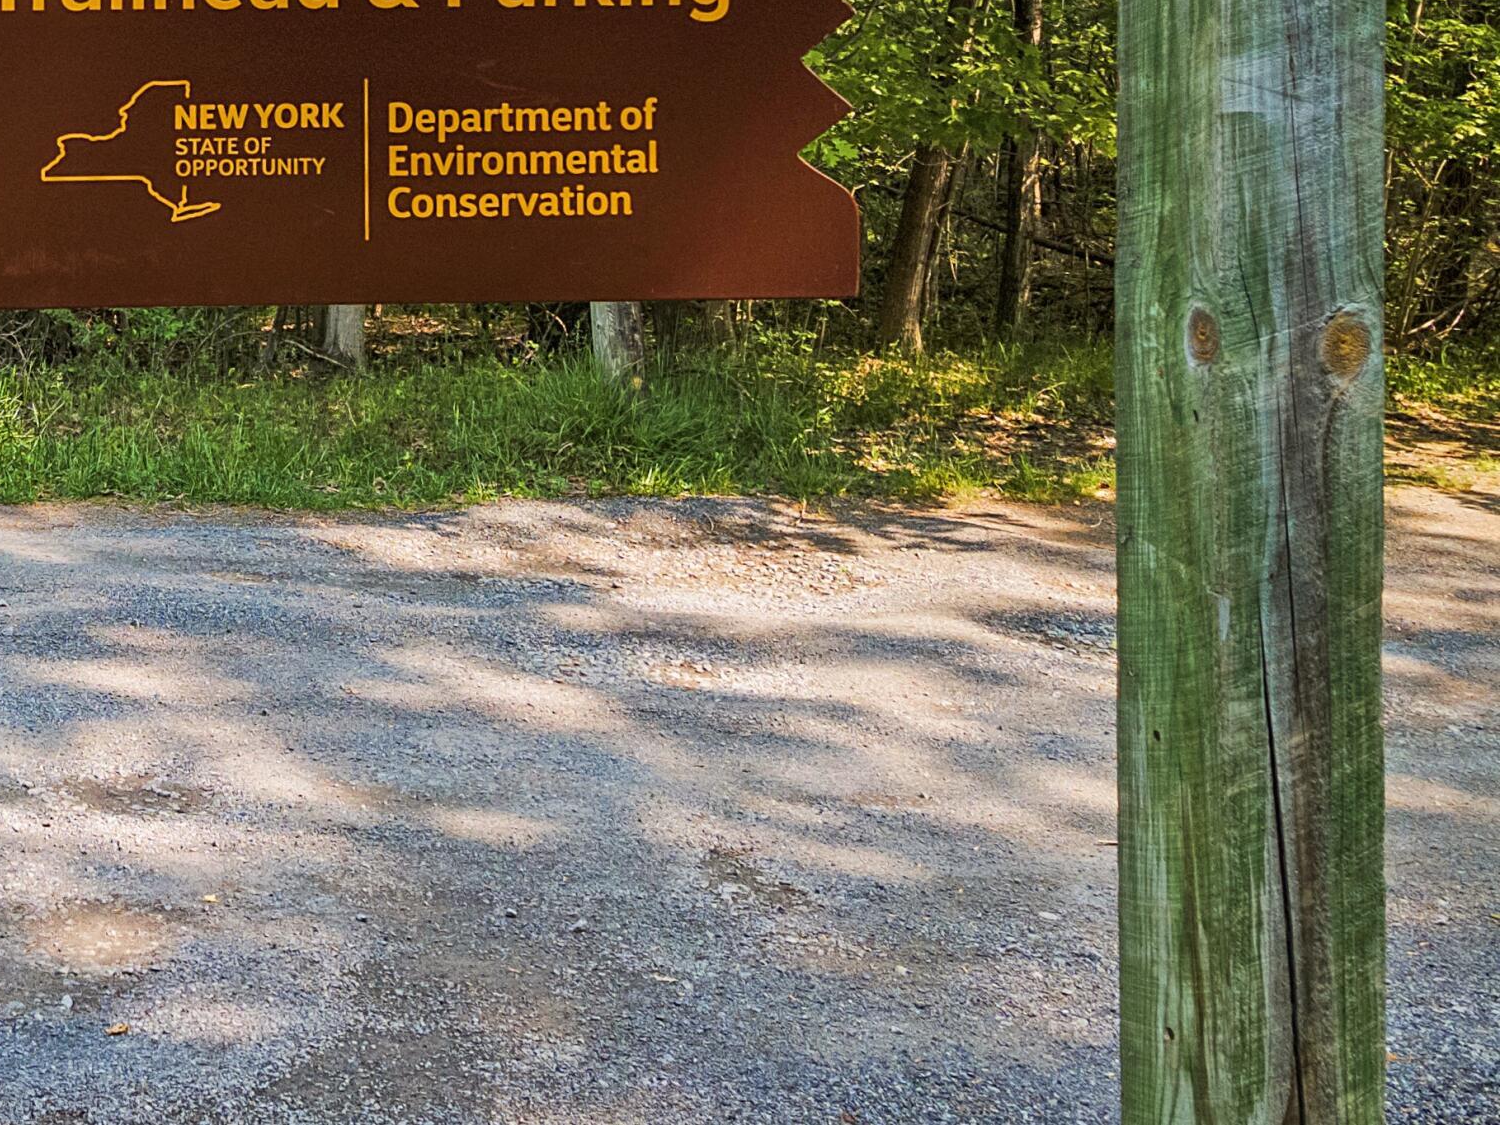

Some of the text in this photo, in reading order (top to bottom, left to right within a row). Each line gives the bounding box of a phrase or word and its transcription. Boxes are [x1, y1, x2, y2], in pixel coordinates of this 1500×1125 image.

[175, 103, 343, 129] NEW YORK
[389, 98, 657, 140] Department of
[176, 137, 271, 154] STATE OF
[389, 139, 658, 176] Environmental
[176, 158, 325, 176] OPPORTUNITY
[388, 185, 632, 218] Conservation
